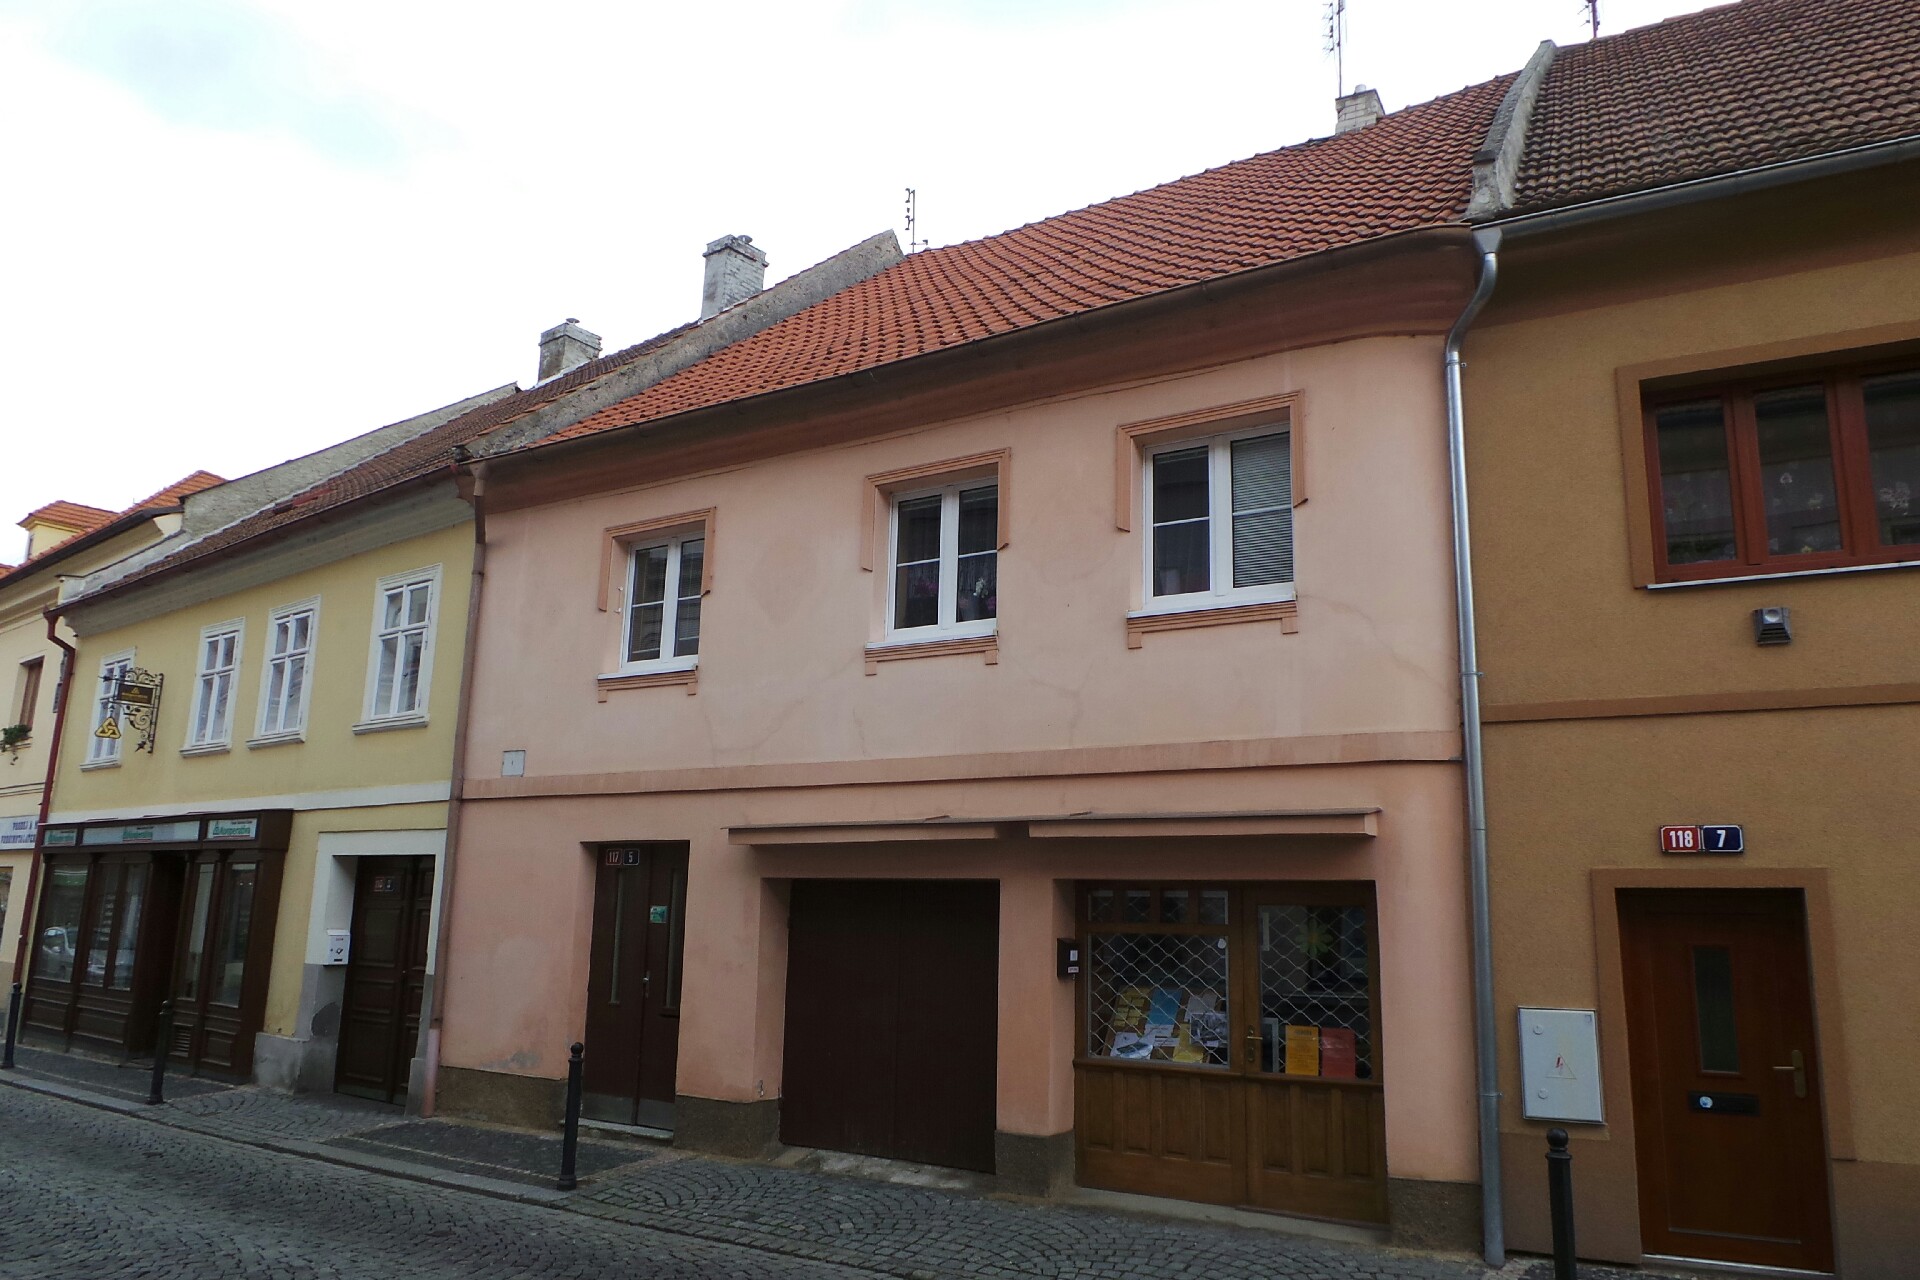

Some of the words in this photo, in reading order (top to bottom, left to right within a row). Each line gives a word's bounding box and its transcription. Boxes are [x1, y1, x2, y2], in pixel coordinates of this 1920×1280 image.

[1669, 830, 1694, 848] 118
[1716, 829, 1726, 848] 7
[609, 851, 619, 862] 117
[628, 851, 634, 862] 5
